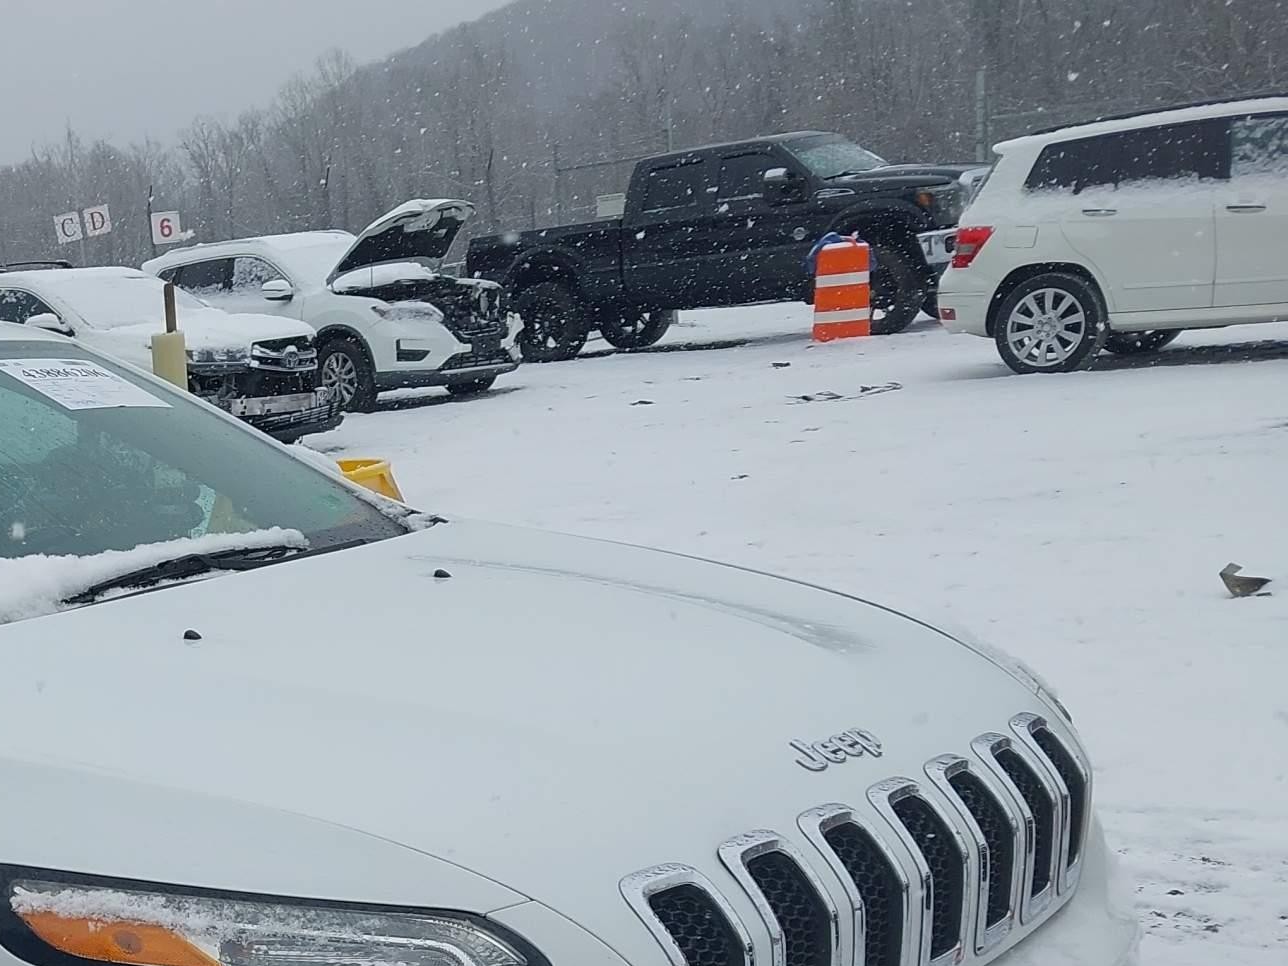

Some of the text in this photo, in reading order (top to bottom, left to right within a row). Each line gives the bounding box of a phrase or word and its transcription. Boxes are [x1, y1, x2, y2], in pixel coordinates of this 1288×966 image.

[61, 210, 106, 238] C D
[159, 217, 173, 238] 6
[789, 727, 883, 772] Jeep
